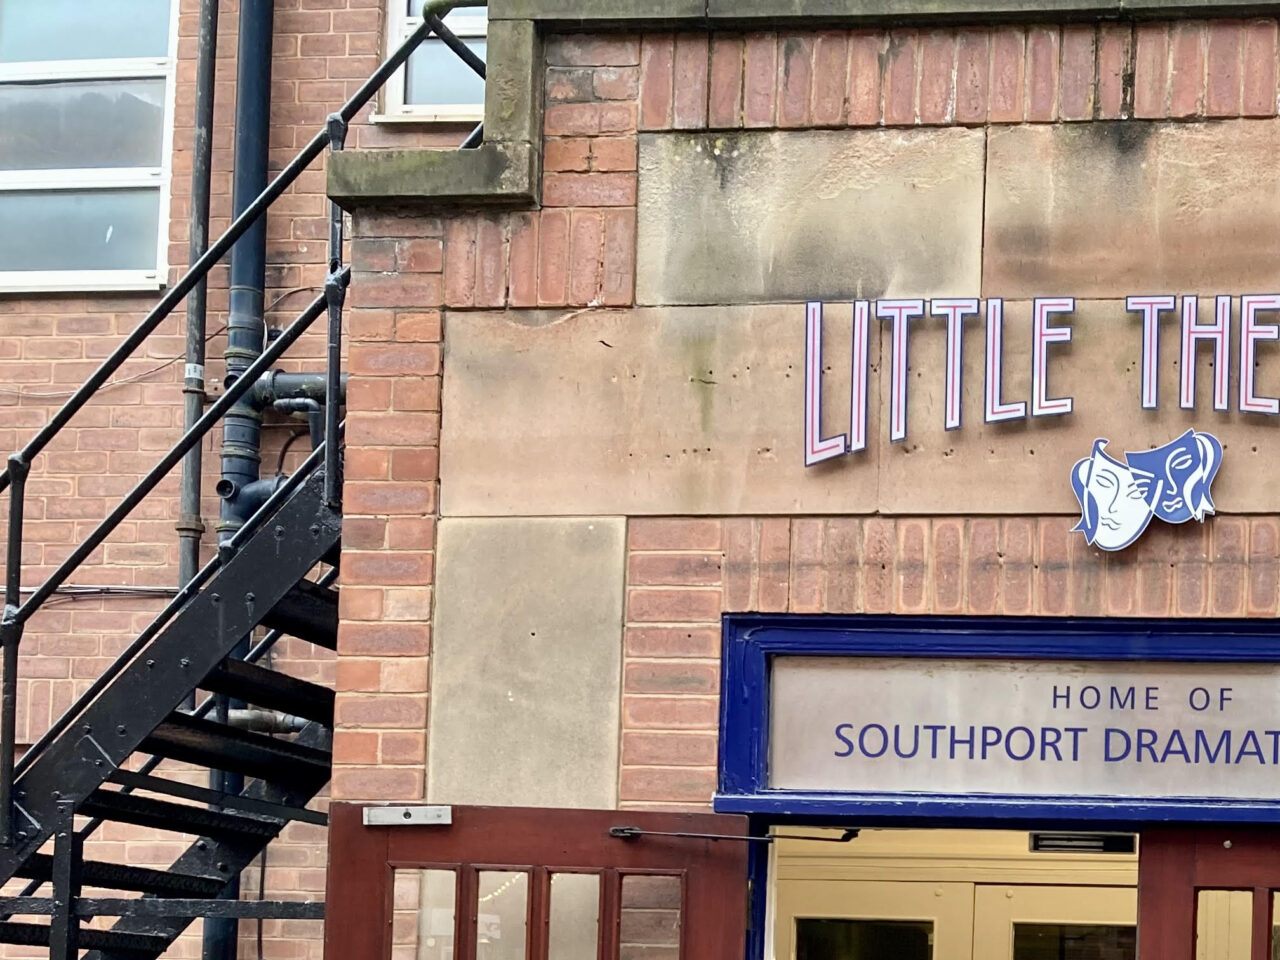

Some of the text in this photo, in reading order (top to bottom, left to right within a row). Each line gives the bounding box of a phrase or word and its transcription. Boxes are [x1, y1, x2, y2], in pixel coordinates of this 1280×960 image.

[804, 297, 1075, 466] LITTLE
[1051, 685, 1234, 712] HOME OF
[834, 722, 1088, 759] SOUTHPORT
